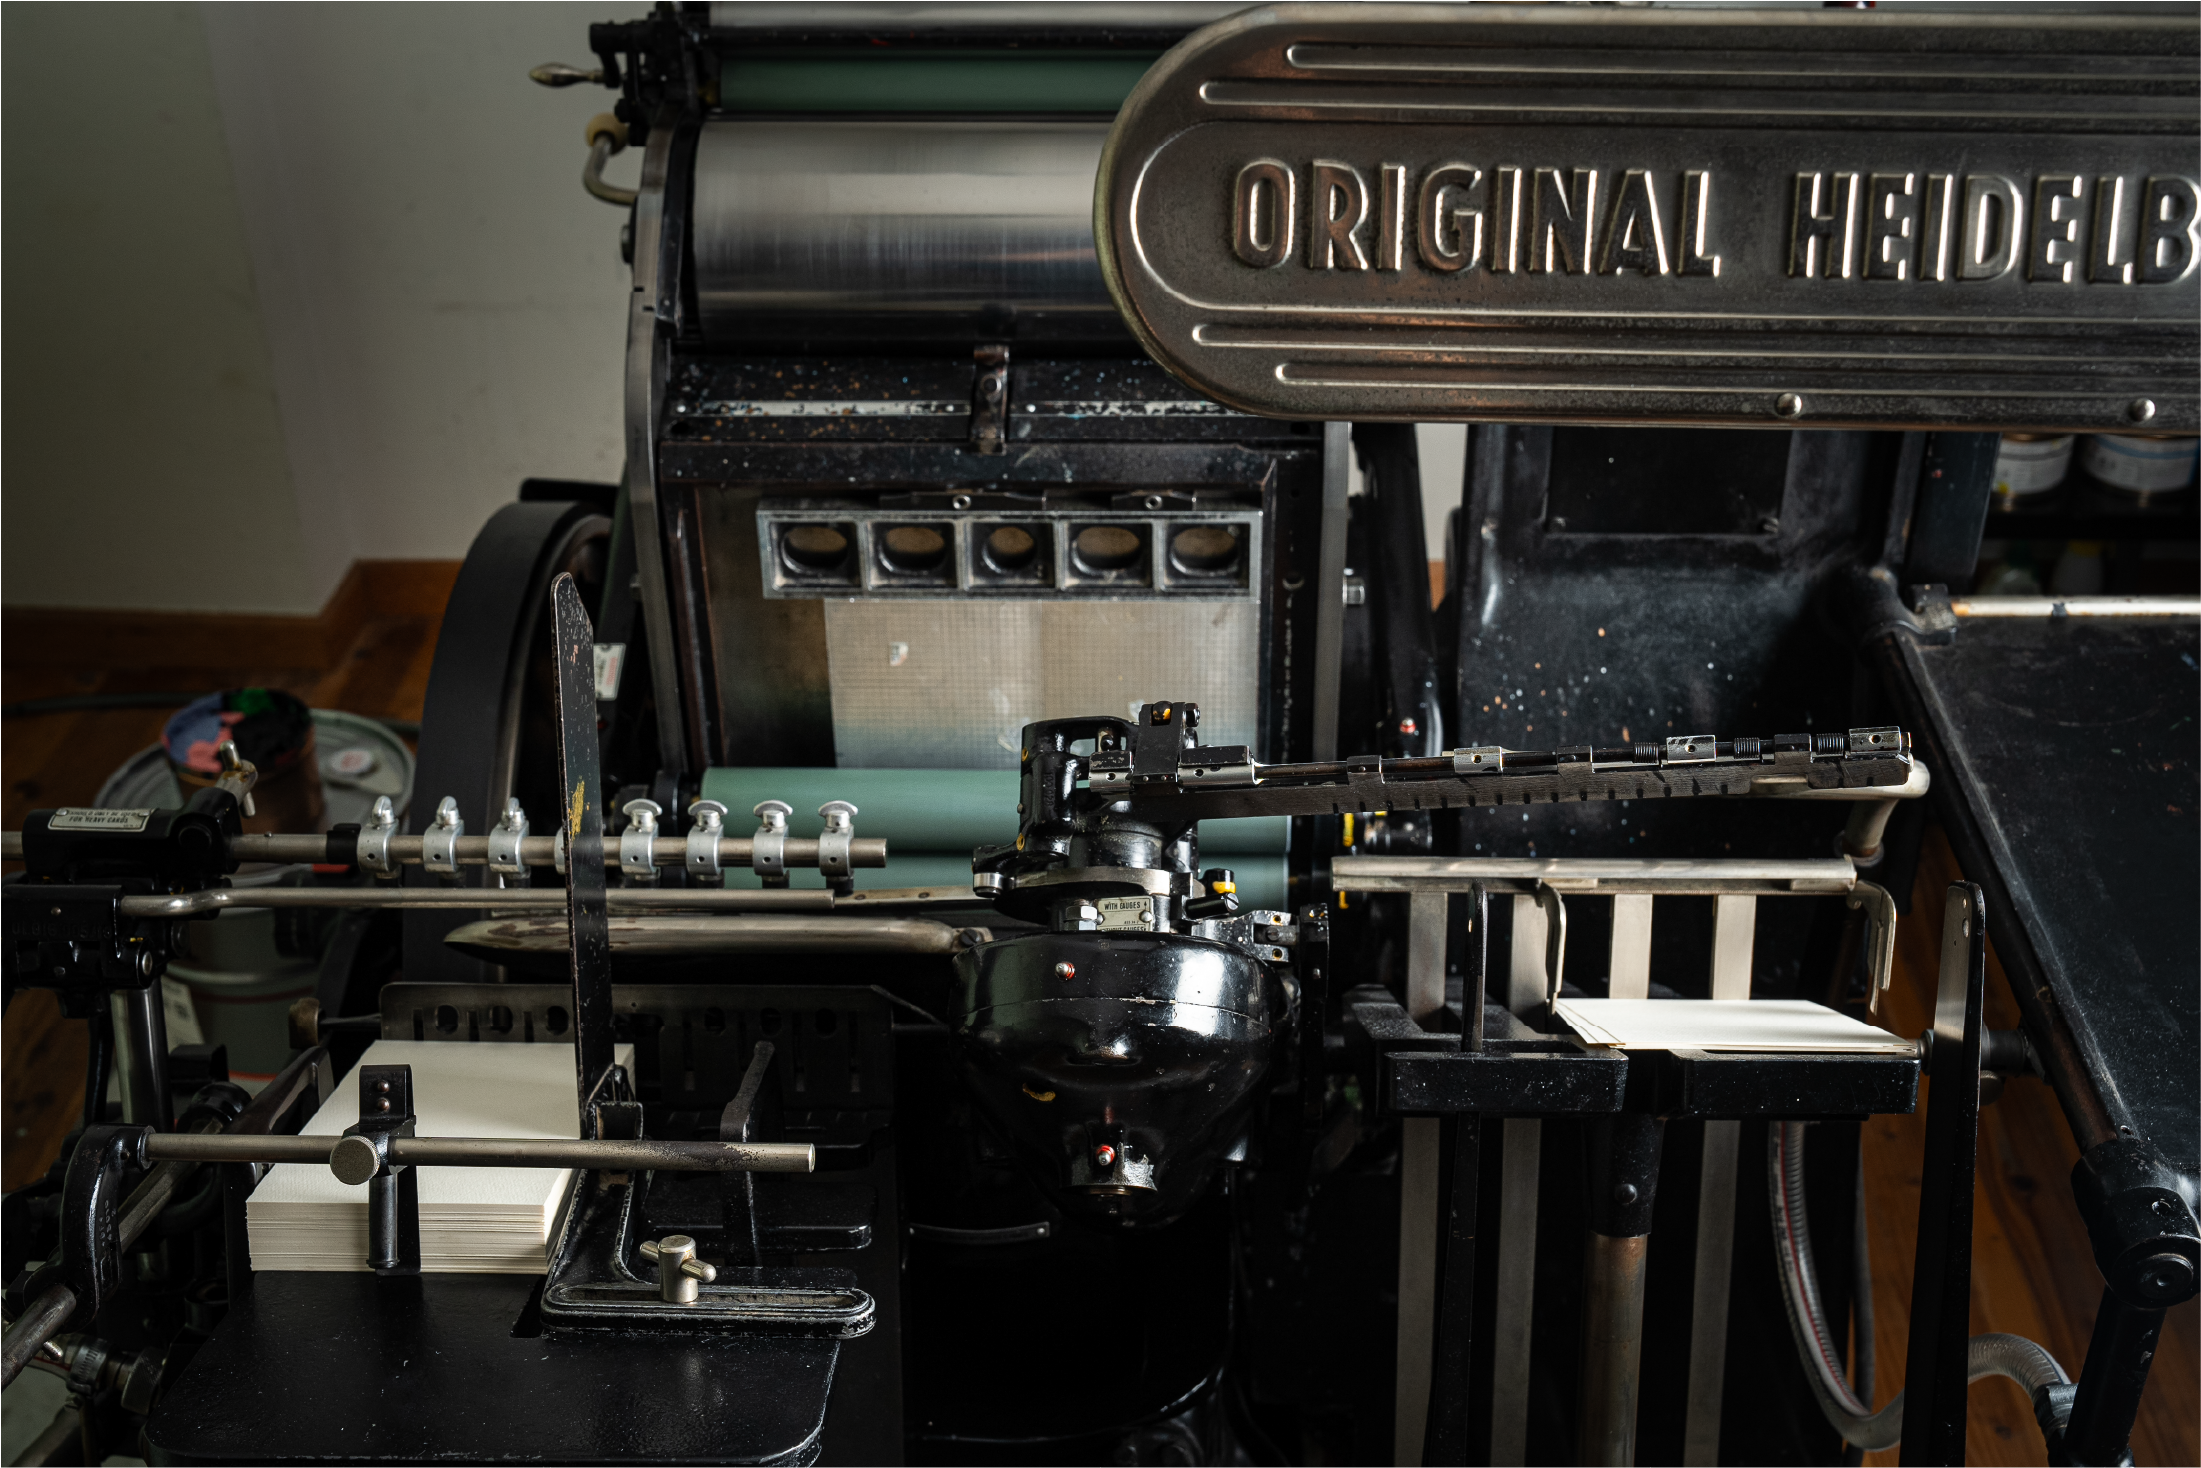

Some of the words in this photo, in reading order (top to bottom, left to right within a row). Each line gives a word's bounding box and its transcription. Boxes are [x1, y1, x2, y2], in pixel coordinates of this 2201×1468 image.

[1231, 156, 1722, 278] ORIGINAL
[1786, 171, 2201, 285] HEIDELB
[1104, 902, 1118, 910] WITH
[1119, 901, 1141, 910] GAUGES
